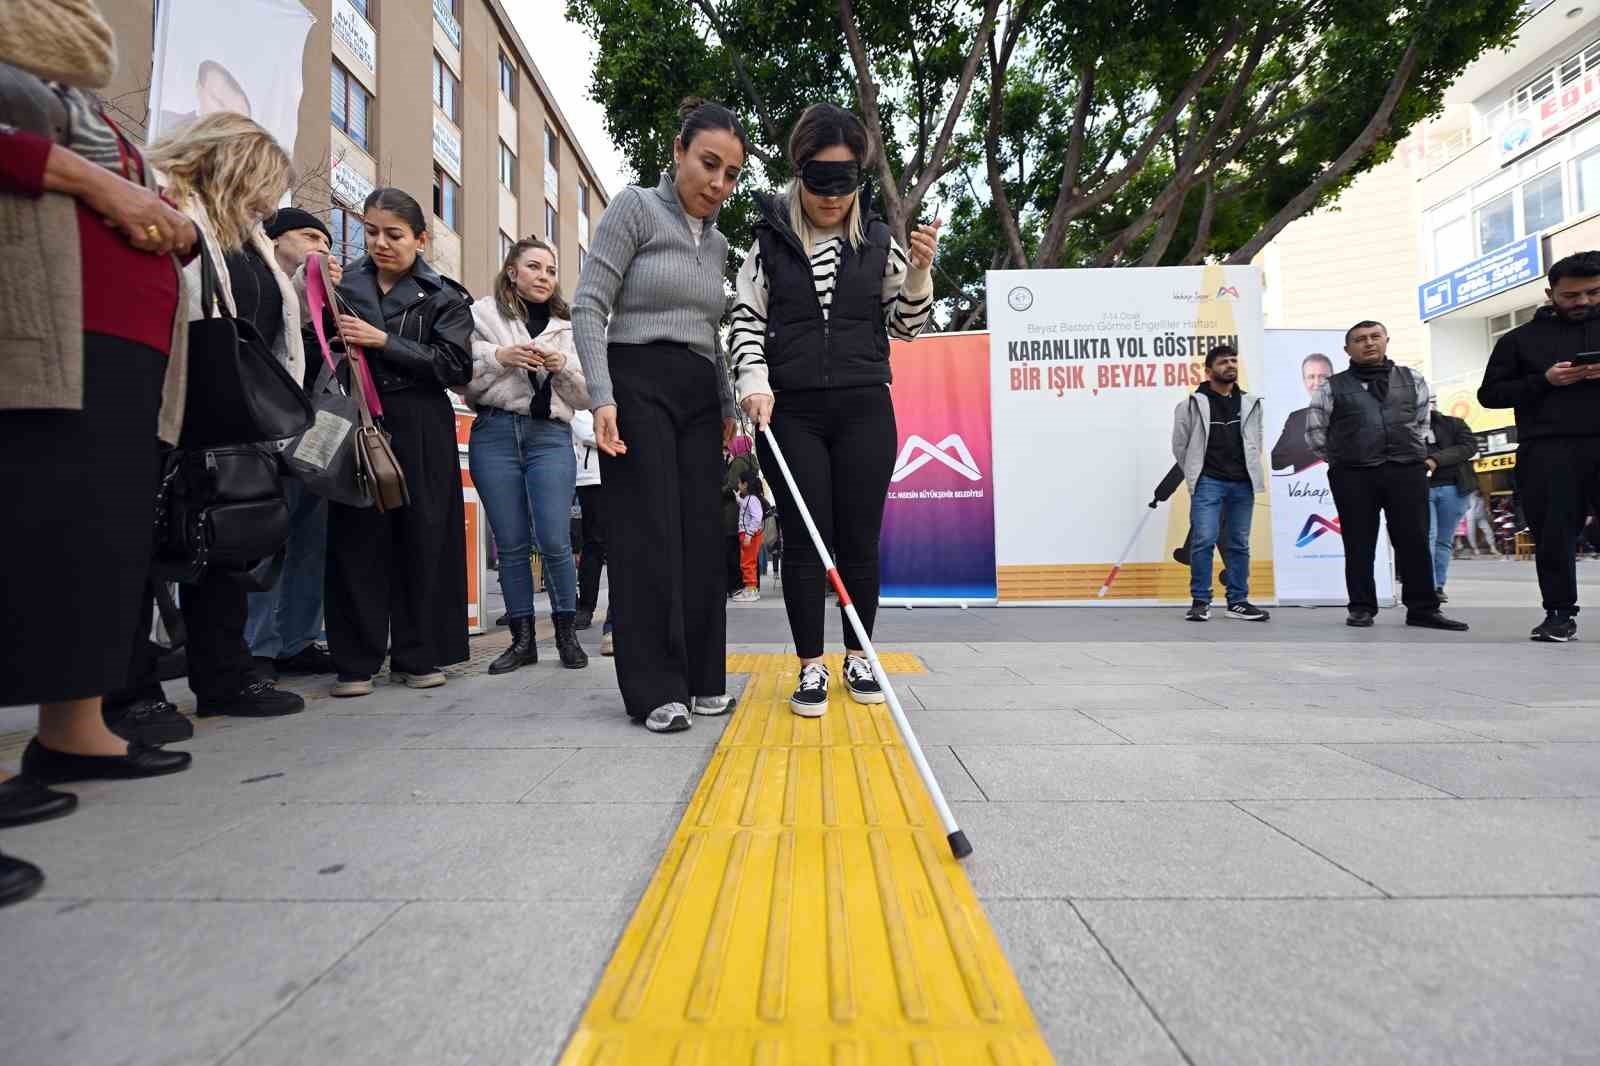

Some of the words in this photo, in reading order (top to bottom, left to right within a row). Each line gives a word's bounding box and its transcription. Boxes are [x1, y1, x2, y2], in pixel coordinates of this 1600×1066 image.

[1027, 323, 1057, 335] Beyaz
[1060, 322, 1094, 332] Baston
[1097, 320, 1132, 331] Görme
[1008, 338, 1110, 361] KARANLIKTA
[1116, 337, 1148, 358] YOL
[1010, 362, 1041, 391] BİR
[1047, 366, 1085, 397] IŞIK
[1163, 363, 1206, 387] BAS
[1288, 481, 1330, 504] Vahap
